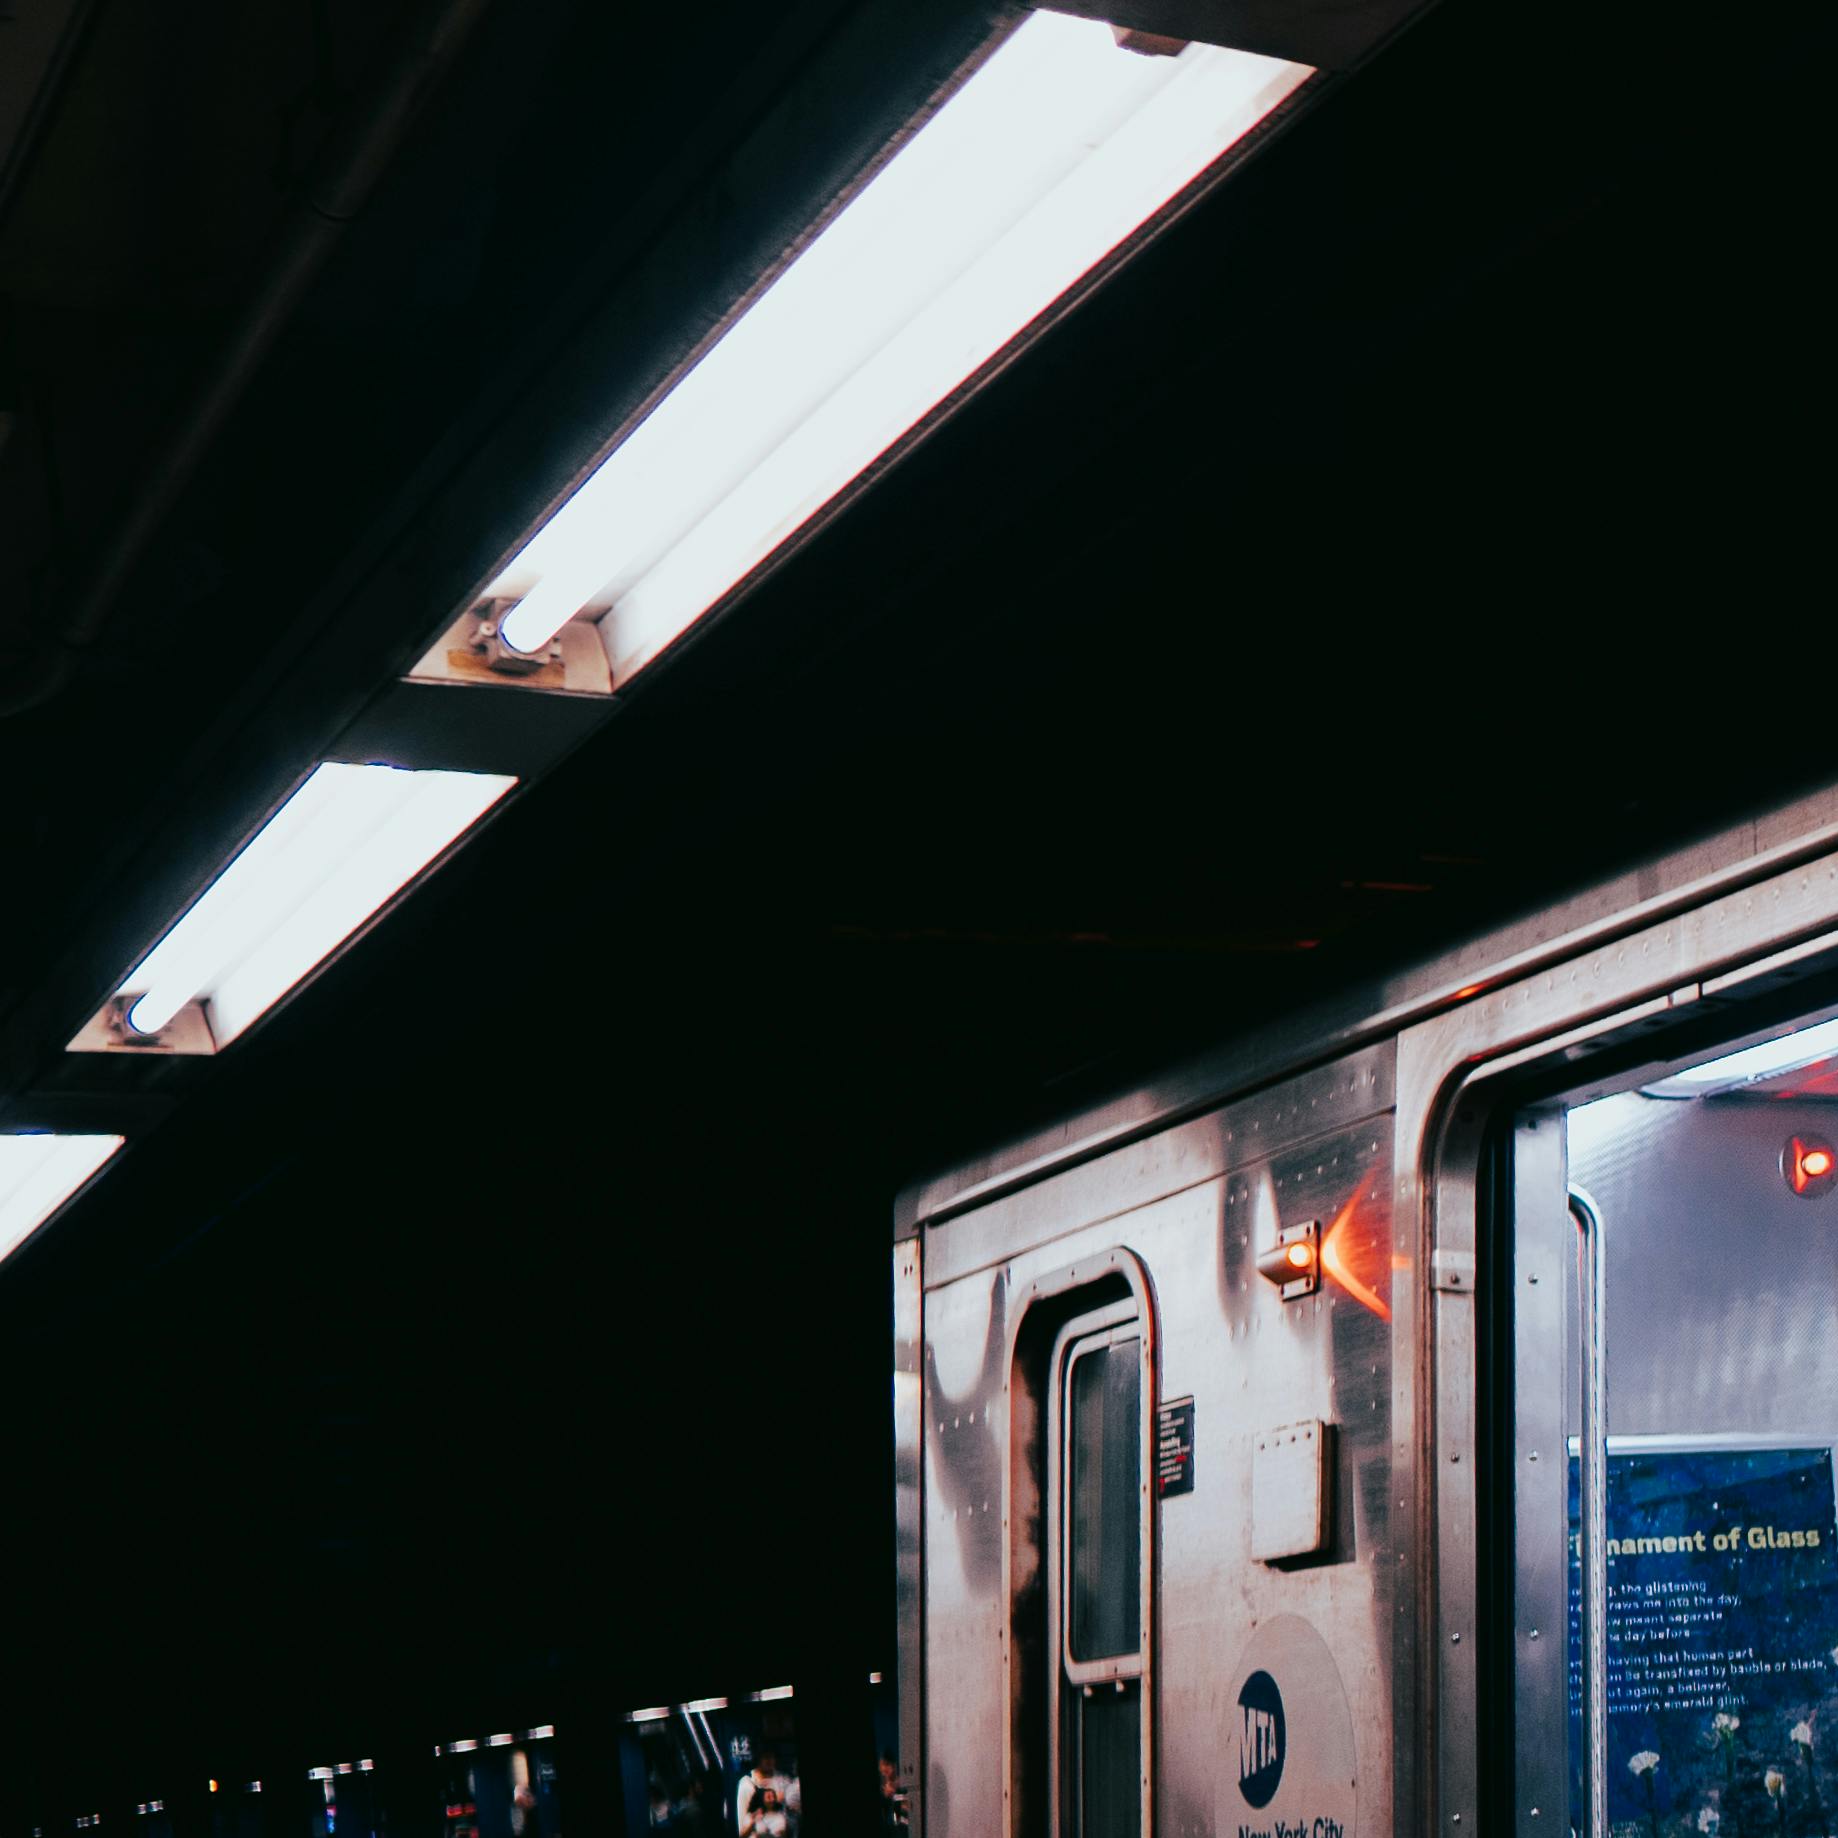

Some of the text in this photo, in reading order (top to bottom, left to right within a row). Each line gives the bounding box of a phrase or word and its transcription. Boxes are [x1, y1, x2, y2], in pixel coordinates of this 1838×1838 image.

[1713, 1527, 1742, 1551] of
[1747, 1526, 1821, 1550] Glass
[1238, 1703, 1277, 1779] MTA
